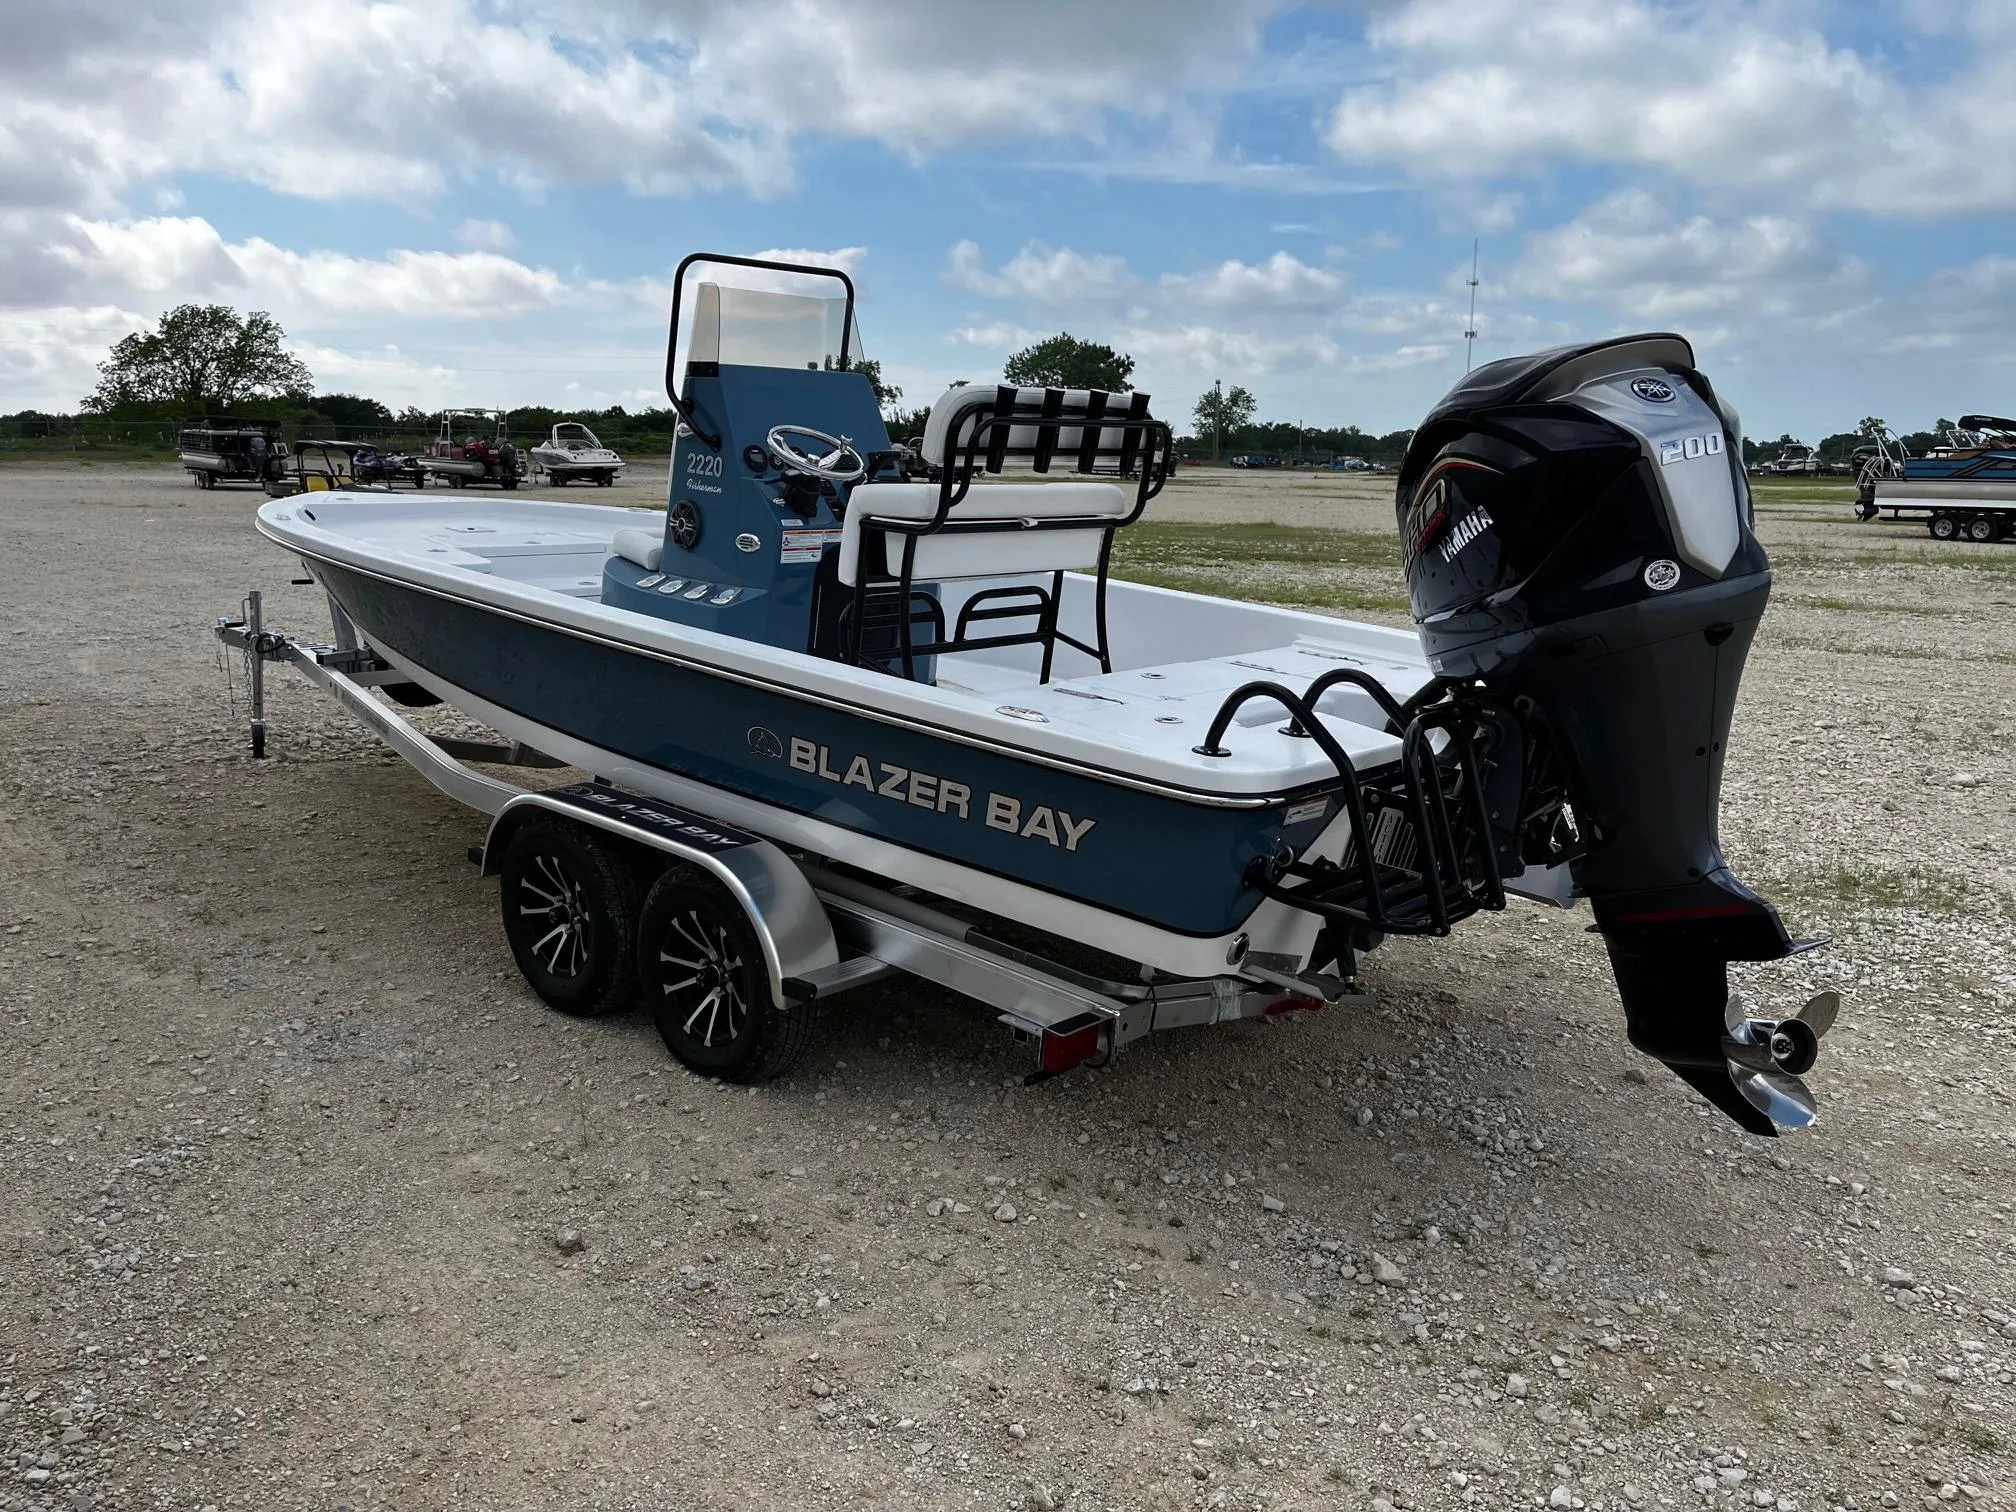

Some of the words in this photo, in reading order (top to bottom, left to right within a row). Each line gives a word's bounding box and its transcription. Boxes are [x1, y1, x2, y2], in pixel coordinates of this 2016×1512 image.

[687, 452, 723, 478] 2220
[1661, 432, 1723, 466] 200
[686, 478, 722, 494] Fisherman
[1439, 505, 1494, 563] YAMAHA
[789, 736, 971, 820] BLAZER
[985, 792, 1097, 851] BAY
[582, 794, 685, 828] BLAZER
[676, 825, 743, 846] BAY
